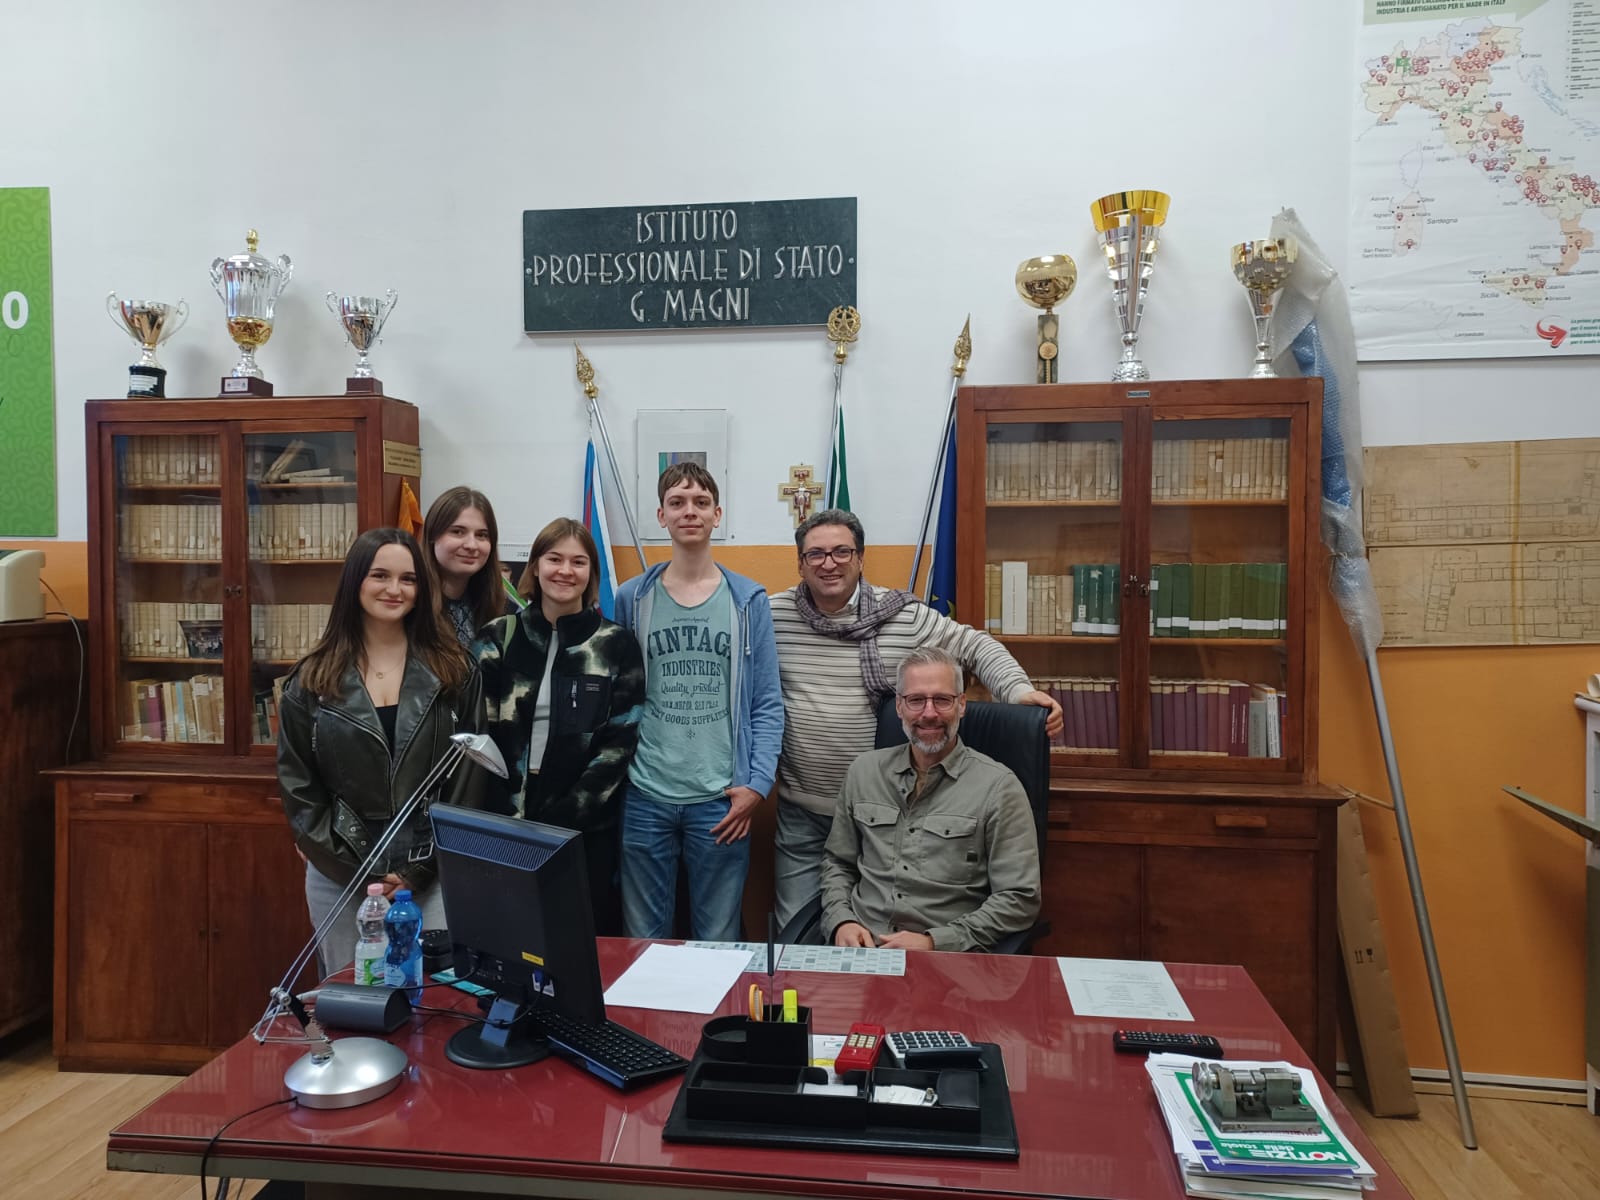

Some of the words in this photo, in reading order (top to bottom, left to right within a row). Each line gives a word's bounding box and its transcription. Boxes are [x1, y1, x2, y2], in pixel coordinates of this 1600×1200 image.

[636, 209, 738, 244] ISTITUTO
[532, 249, 729, 286] PROFESSIONALE
[738, 247, 761, 281] DI
[773, 245, 844, 281] STATO
[629, 290, 651, 323] G.
[662, 287, 750, 322] MAGNI
[647, 625, 731, 660] INTAG
[662, 660, 721, 677] INDUSTRIES
[661, 682, 689, 697] Quality
[664, 713, 690, 725] GOODS
[1247, 1149, 1348, 1162] NOTIZIE
